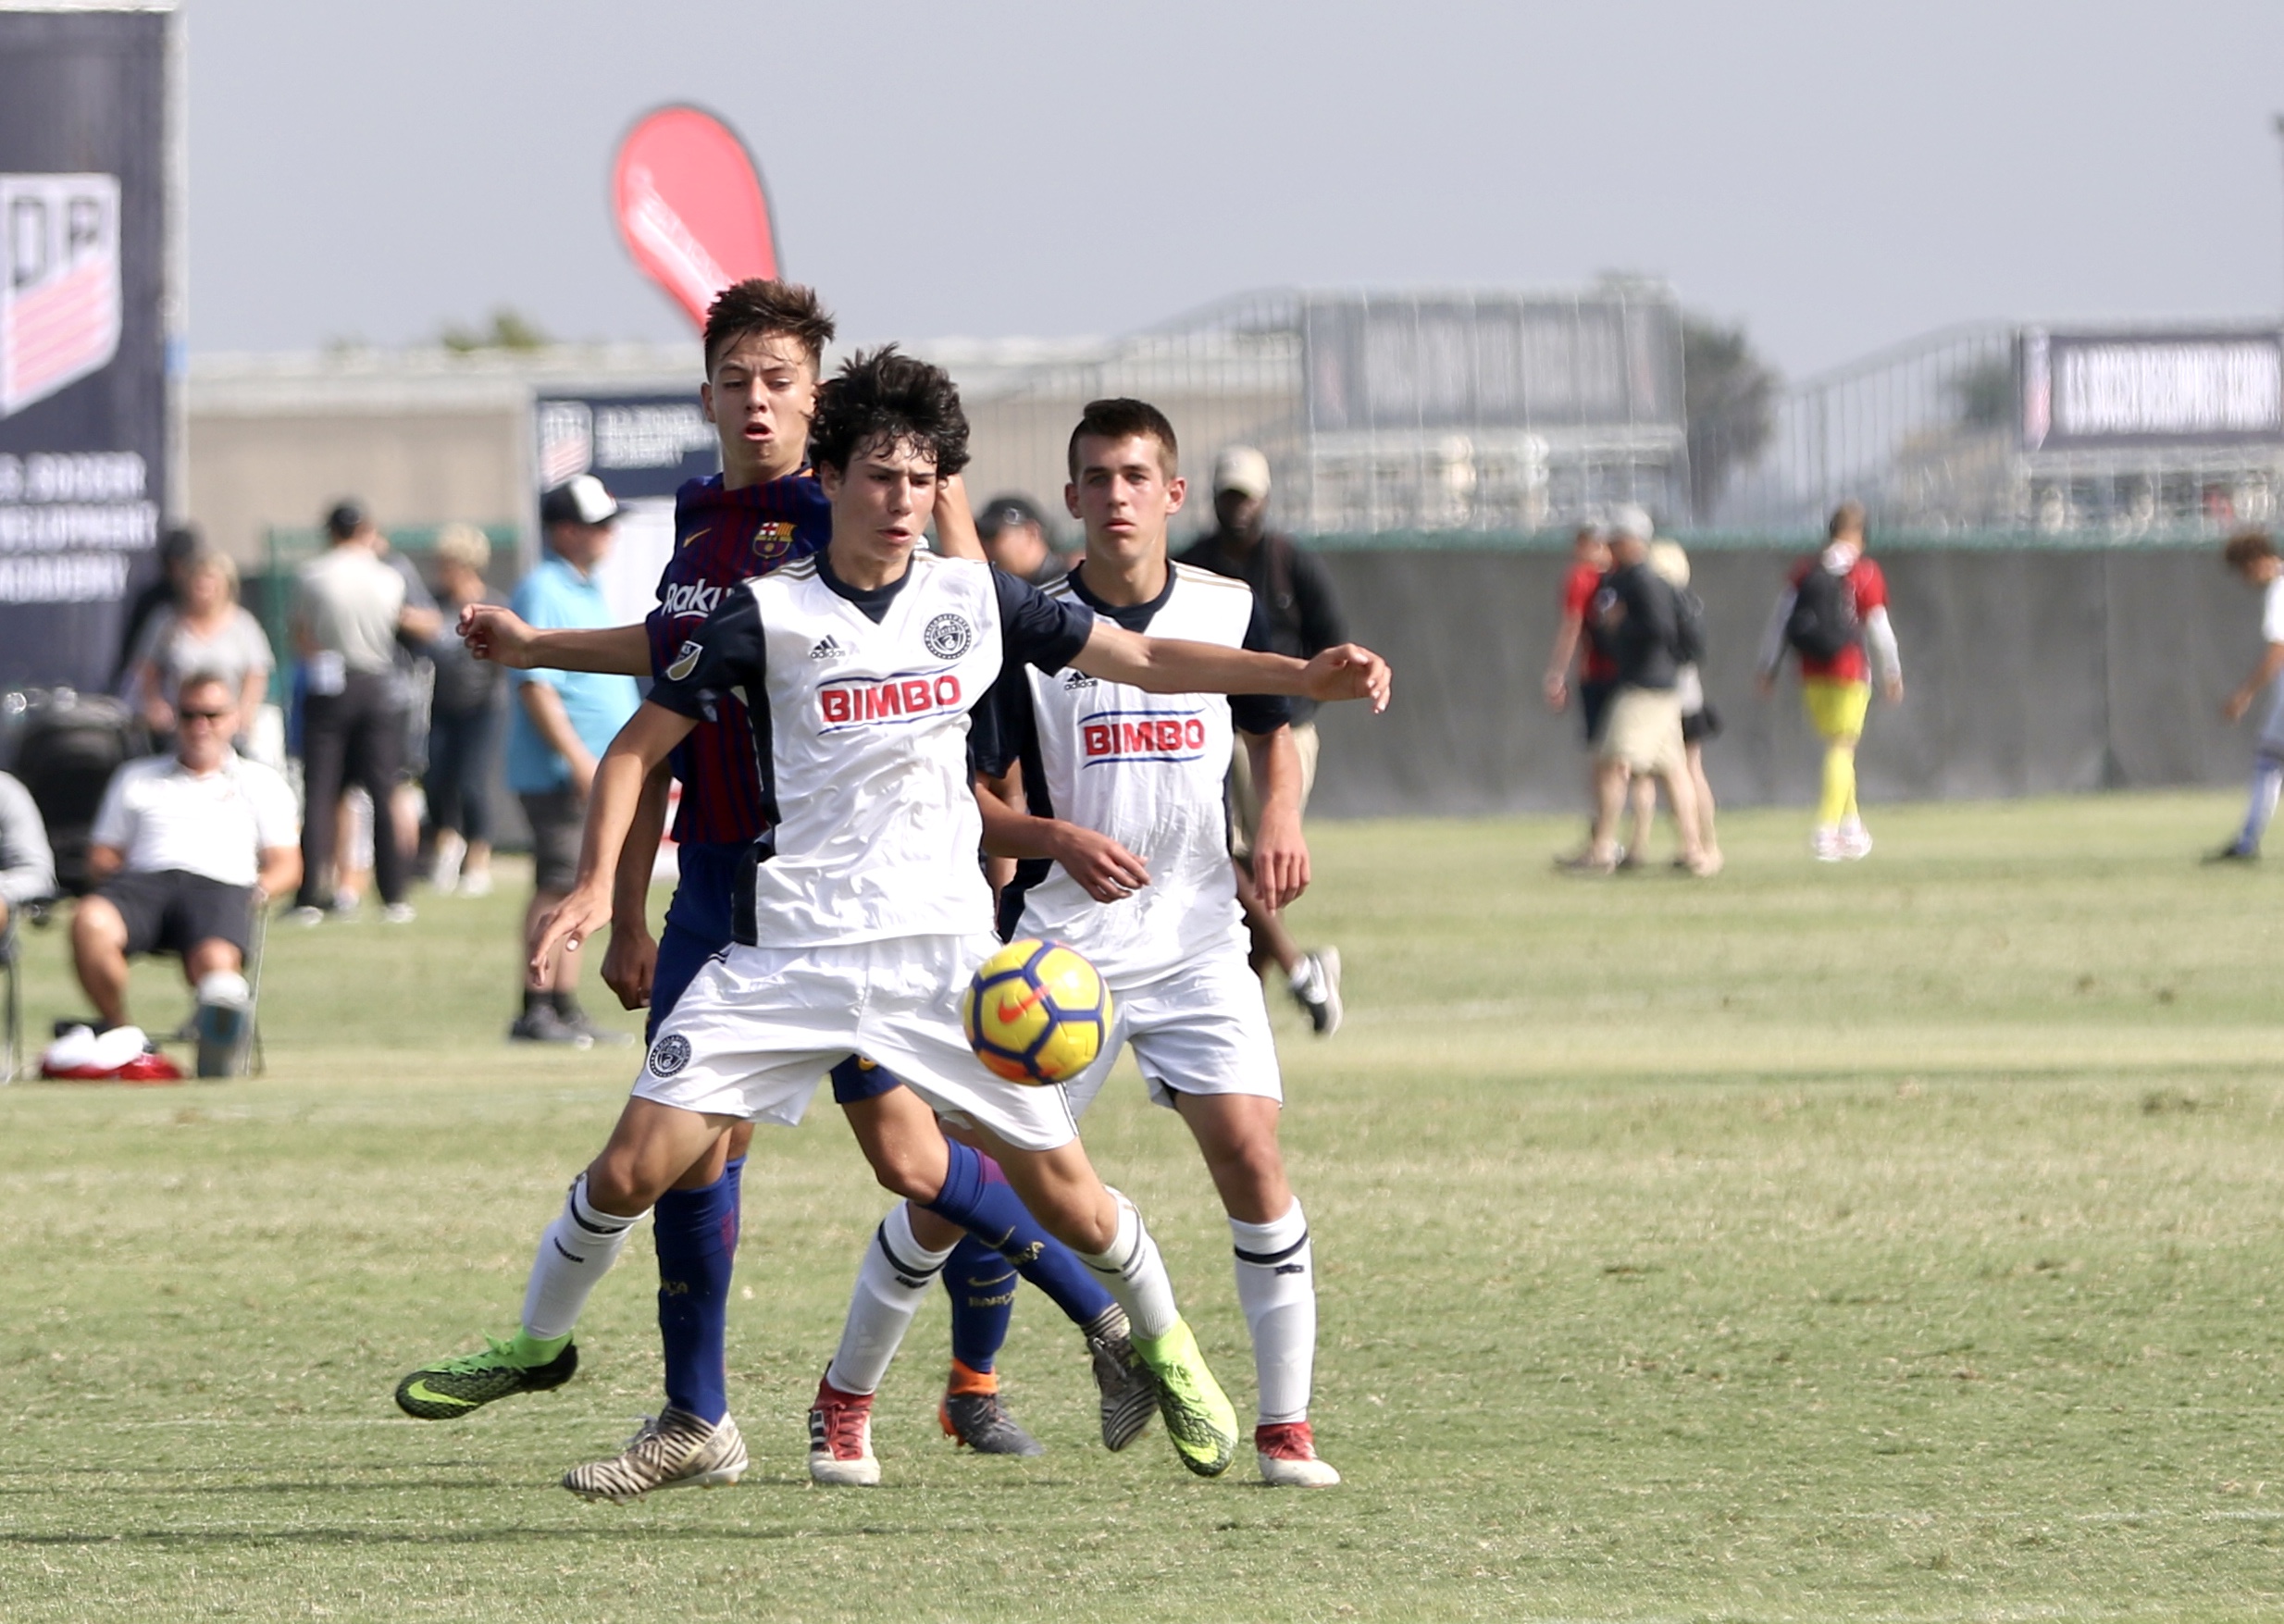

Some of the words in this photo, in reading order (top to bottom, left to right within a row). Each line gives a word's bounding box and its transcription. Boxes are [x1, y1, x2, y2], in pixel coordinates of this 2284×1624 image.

[810, 648, 846, 659] adidas
[1064, 678, 1099, 690] adidas
[822, 675, 962, 723] BIMBO
[1084, 718, 1205, 756] BIMBO
